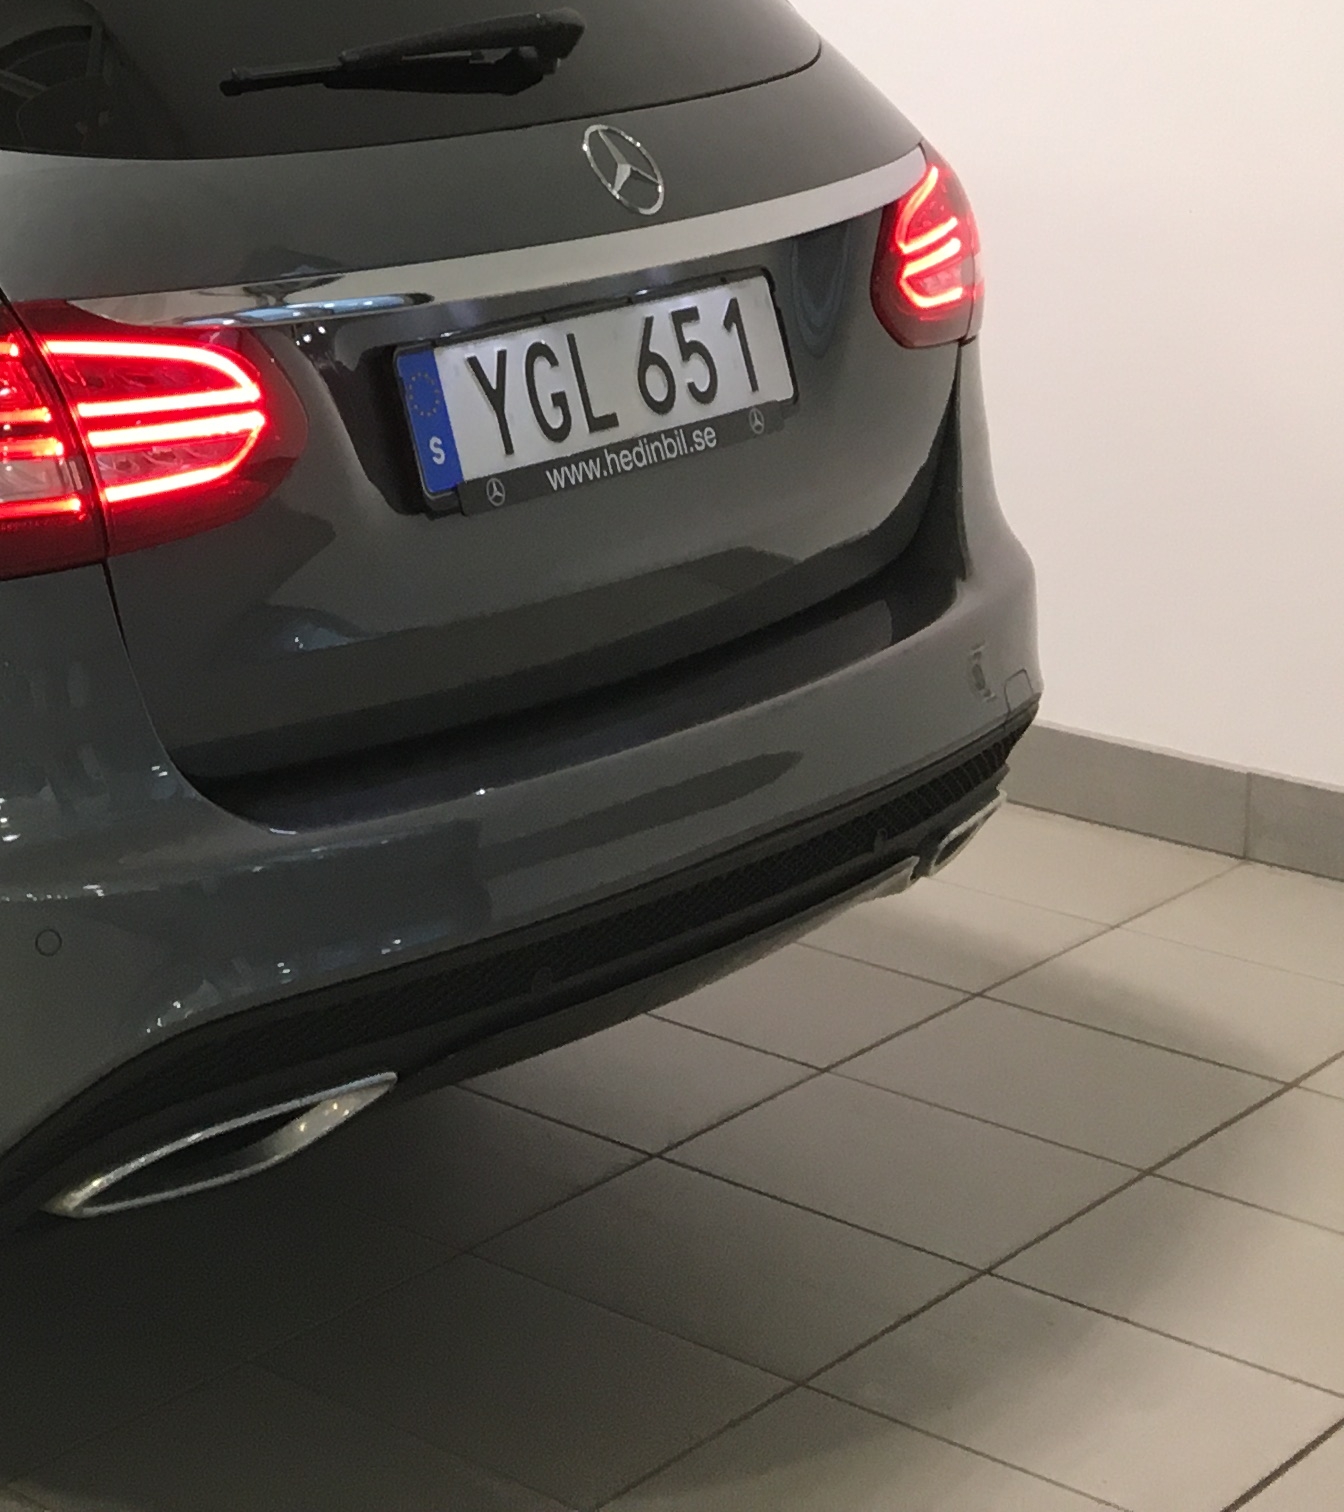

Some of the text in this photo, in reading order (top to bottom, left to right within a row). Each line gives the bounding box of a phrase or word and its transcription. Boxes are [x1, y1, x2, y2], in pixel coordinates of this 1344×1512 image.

[466, 296, 762, 457] YGL 651
[429, 435, 446, 466] S
[545, 426, 718, 492] www.hedinbil.se
